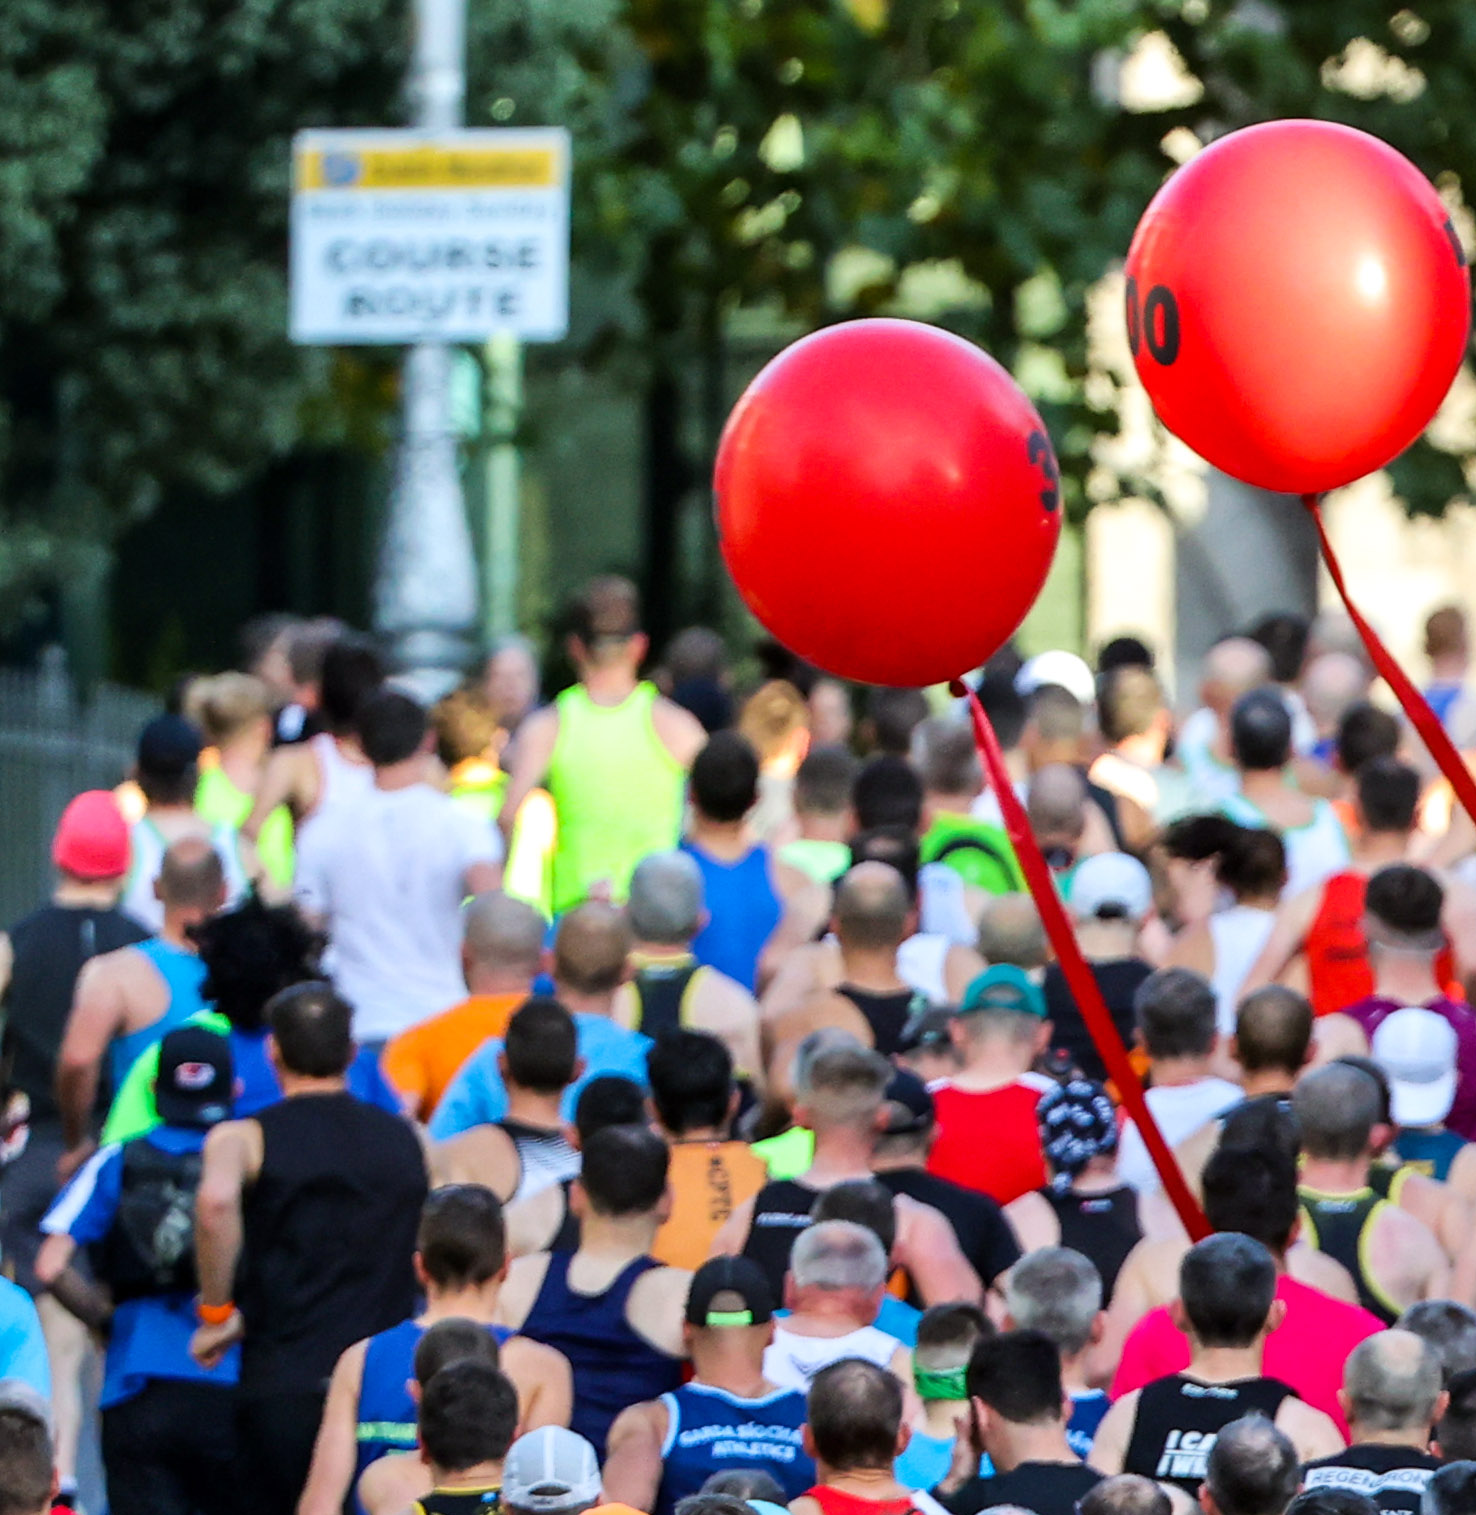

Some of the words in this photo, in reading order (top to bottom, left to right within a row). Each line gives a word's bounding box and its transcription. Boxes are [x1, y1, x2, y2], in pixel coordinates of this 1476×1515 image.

[323, 238, 540, 280] COURSE
[344, 283, 519, 321] ROUTE
[712, 1440, 796, 1464] ATHLETICS
